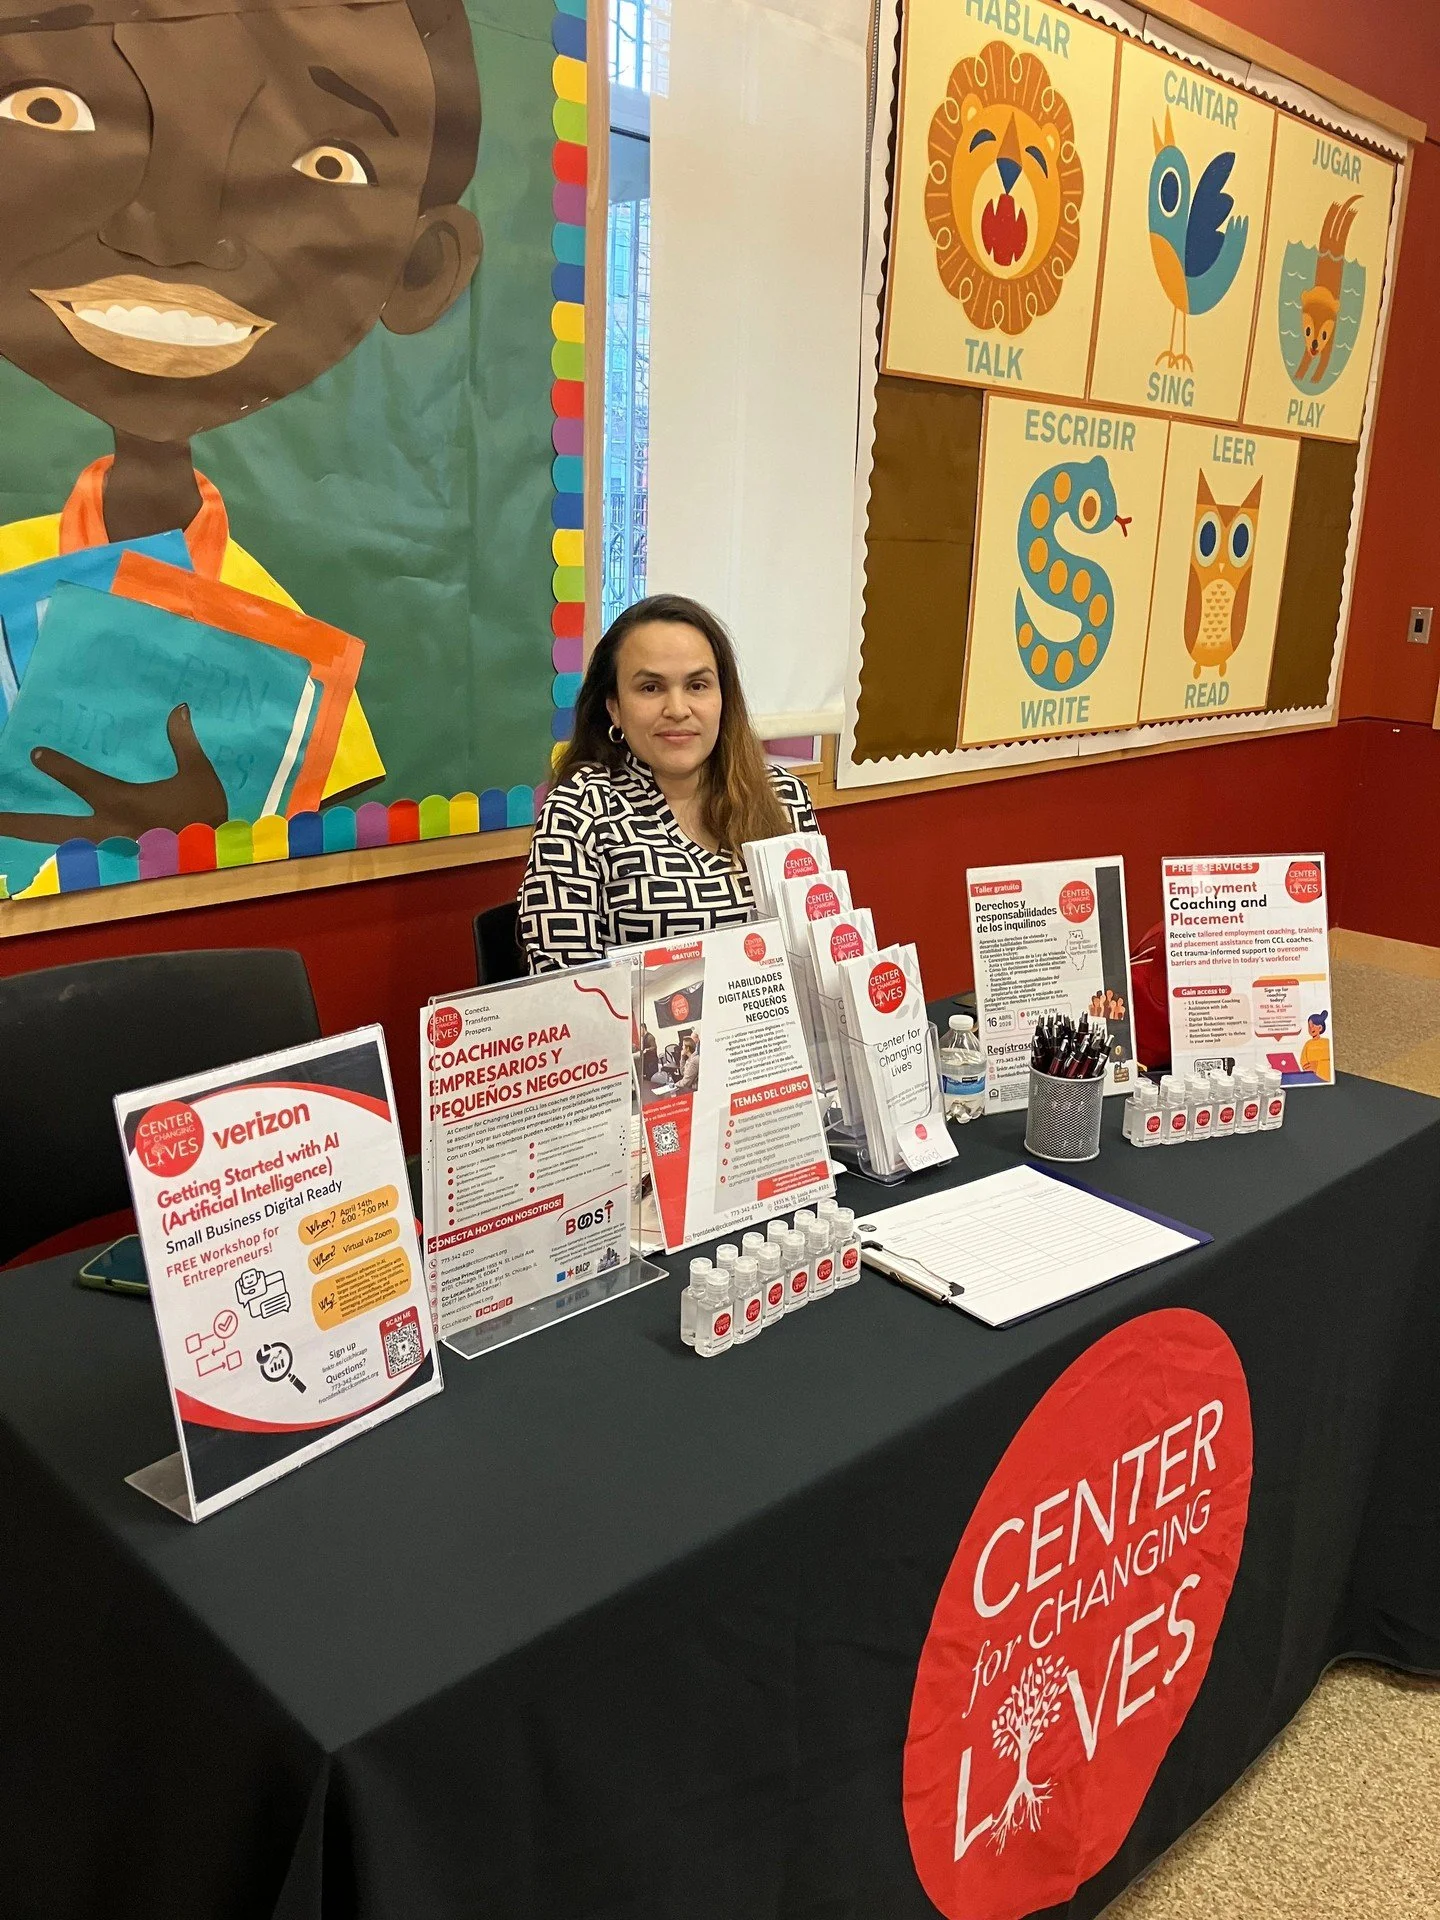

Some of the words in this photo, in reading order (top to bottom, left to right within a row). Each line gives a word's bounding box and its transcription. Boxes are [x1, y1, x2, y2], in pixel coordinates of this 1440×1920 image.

[965, 0, 1071, 60] HABLAR
[1163, 70, 1239, 131] CANTAR
[1312, 138, 1362, 185] JUGAR
[965, 338, 1023, 381] TALK
[1147, 371, 1195, 408] SING
[1287, 398, 1326, 430] PLAY
[1025, 409, 1136, 452] ESCRIBIR
[1212, 434, 1257, 467] LEER
[1184, 681, 1230, 710] READ
[1020, 695, 1091, 730] WRITE
[785, 856, 813, 869] CENTER
[1171, 863, 1198, 873] FREE
[1202, 862, 1254, 872] SERVICES
[1289, 870, 1318, 878] CENTER
[807, 892, 834, 904] CENTER
[975, 885, 993, 894] Taller
[994, 883, 1020, 894] gratuito
[1061, 888, 1090, 898] CENTER
[1169, 882, 1258, 898] Employment
[1290, 884, 1319, 895] LIVES
[975, 900, 1018, 912] Derechos
[1019, 899, 1026, 909] y
[976, 906, 1057, 923] responsabilidades
[1062, 903, 1092, 916] LIVES
[1169, 897, 1237, 912] Coaching
[1241, 894, 1267, 908] and
[977, 925, 988, 933] de
[989, 922, 1003, 932] los
[1004, 918, 1046, 931] inquilinos
[1170, 912, 1244, 926] Placement
[831, 931, 858, 946] CENTER
[1170, 931, 1196, 939] Receive
[1197, 930, 1223, 938] tailored
[1224, 929, 1265, 938] employment
[1266, 928, 1297, 937] coaching,
[1298, 927, 1323, 935] training
[1170, 940, 1183, 948] and
[1184, 939, 1219, 949] placement
[1220, 938, 1254, 946] assistance
[1254, 937, 1271, 945] from
[672, 950, 700, 960] GRATUITO
[1170, 950, 1183, 958] Get
[1184, 948, 1241, 957] trauma-informed
[1242, 947, 1267, 956] support
[1276, 945, 1309, 953] overcome
[1171, 959, 1197, 967] barriers
[1198, 958, 1211, 966] and
[1212, 957, 1232, 965] thrive
[1240, 955, 1264, 964] today's
[1265, 954, 1301, 963] workforce!
[728, 972, 783, 990] HABILIDADES
[869, 969, 900, 987] CENTER
[718, 988, 761, 1004] DIGITALES
[762, 983, 785, 995] PARA
[743, 994, 787, 1011] PEQUEÑOS
[872, 986, 904, 1007] LIVES
[745, 1006, 790, 1023] NEGOCIOS
[987, 1017, 998, 1027] 16
[428, 1035, 524, 1072] COACHING
[528, 1023, 571, 1049] PARA
[877, 1033, 905, 1053] Center
[907, 1028, 921, 1039] for
[879, 1042, 922, 1068] Changing
[429, 1052, 547, 1097] EMPRESARIOS
[550, 1048, 563, 1065] Y
[891, 1061, 912, 1077] Lives
[429, 1082, 523, 1122] PEQUEÑOS
[526, 1058, 609, 1096] NEGOCIOS
[733, 1093, 763, 1108] TEMAS
[764, 1088, 779, 1098] DEL
[780, 1081, 808, 1095] CURSO
[454, 1124, 474, 1133] Center
[483, 1113, 510, 1125] Changing
[548, 1097, 568, 1107] coaches
[576, 1087, 600, 1099] pequeños
[601, 1082, 622, 1091] negocios
[139, 1112, 194, 1137] CENTER
[153, 1124, 195, 1143] CHANGING
[212, 1102, 311, 1150] verizon
[144, 1137, 199, 1168] LIVES
[157, 1180, 222, 1209] Getting
[225, 1150, 285, 1186] Started
[286, 1139, 321, 1163] with
[325, 1132, 340, 1151] AI
[162, 1188, 238, 1236] (Artificial
[241, 1156, 332, 1203] Intelligence)
[166, 1230, 203, 1254] Small
[205, 1210, 262, 1240] Business
[264, 1192, 304, 1218] Digital
[307, 1179, 342, 1202] Ready
[306, 1210, 336, 1237] When?
[340, 1206, 356, 1218] April
[357, 1199, 373, 1211] 14th
[341, 1213, 357, 1225] 6:00
[362, 1206, 377, 1217] 7:00
[378, 1200, 389, 1211] PM
[475, 1221, 493, 1237] HOY
[494, 1213, 514, 1229] CON
[515, 1198, 563, 1224] NOSOTROS!
[166, 1256, 198, 1278] FREE
[200, 1233, 261, 1264] Workshop
[263, 1225, 279, 1239] for
[312, 1245, 336, 1268] Where?
[343, 1242, 365, 1253] Virtual
[365, 1236, 374, 1245] via
[374, 1229, 393, 1241] Zoom
[183, 1242, 273, 1287] Entrepreneurs!
[385, 1316, 402, 1328] SCAN
[402, 1311, 411, 1320] ME
[329, 1347, 345, 1360] Sign
[346, 1342, 356, 1354] up
[325, 1357, 367, 1384] Questions?
[973, 1399, 1223, 1619] CENTER
[962, 1634, 1022, 1719] for
[1028, 1489, 1211, 1649] CHANGING
[954, 1573, 1201, 1863] LIVES
